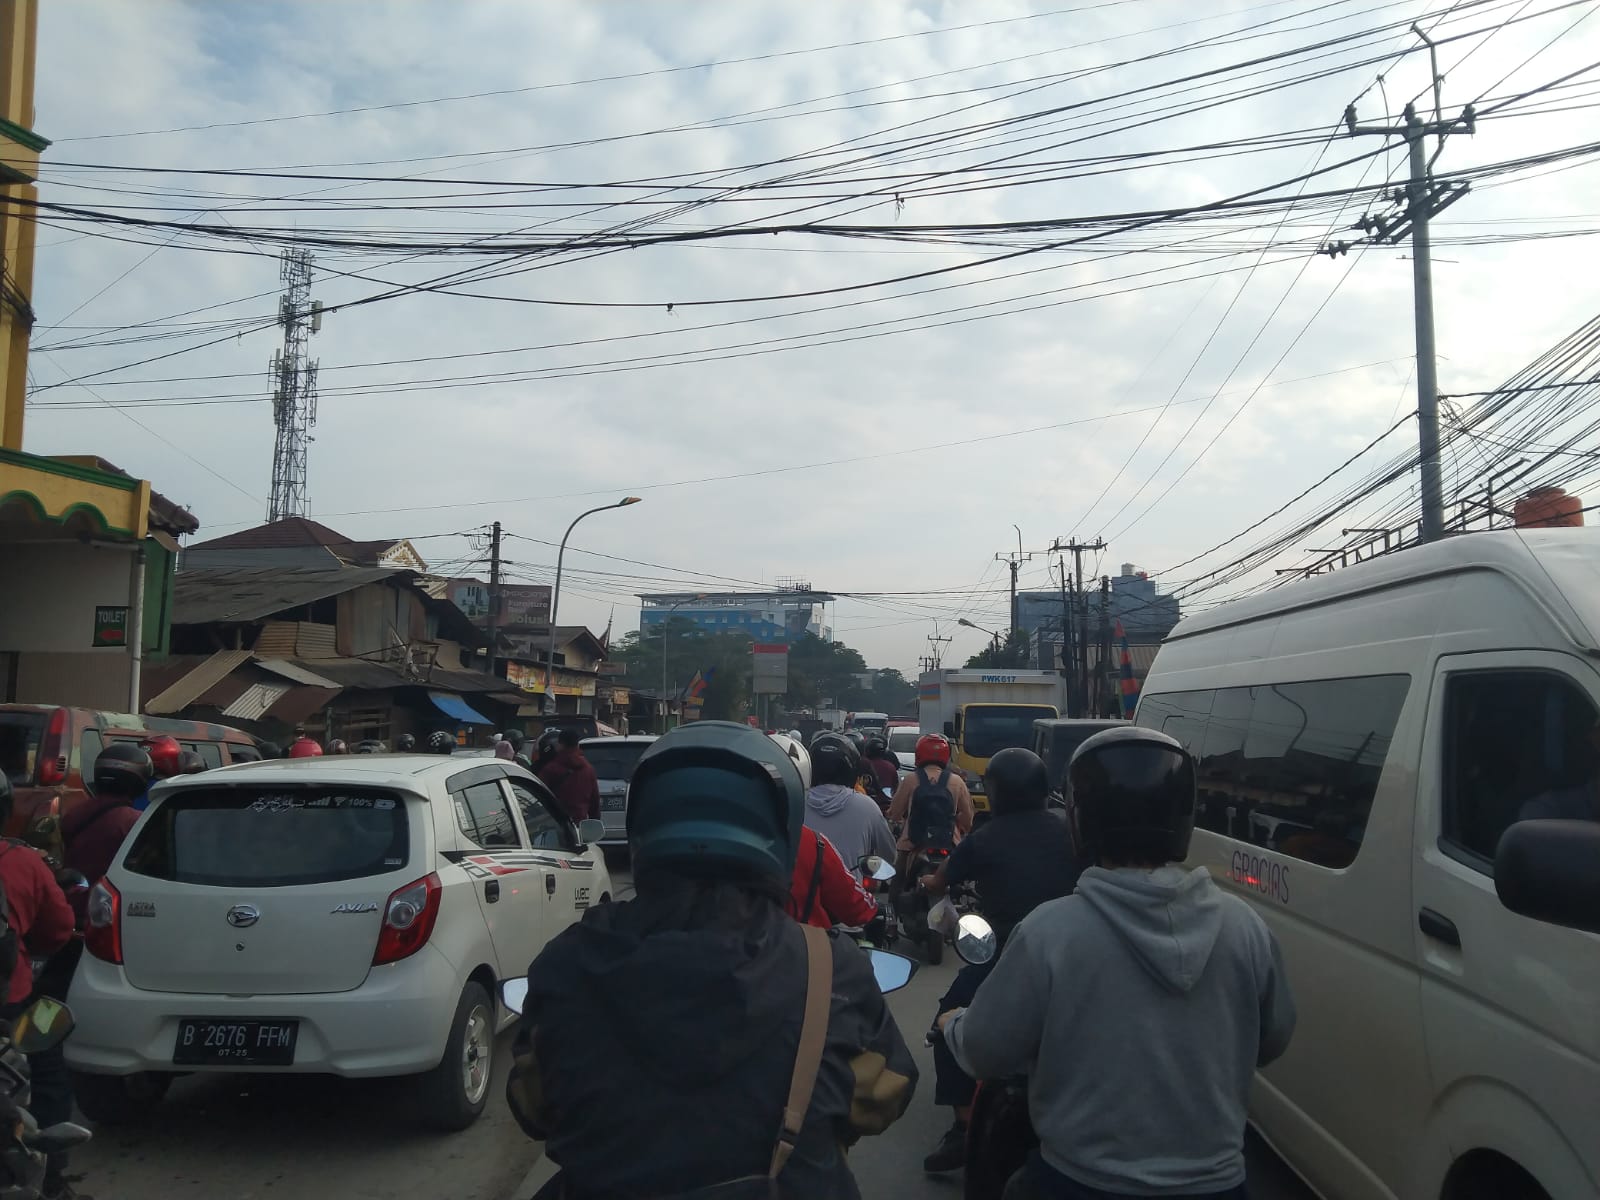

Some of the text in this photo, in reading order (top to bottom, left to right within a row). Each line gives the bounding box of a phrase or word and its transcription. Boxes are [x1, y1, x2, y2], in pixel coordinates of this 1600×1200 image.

[98, 611, 126, 623] TOILET
[347, 798, 373, 807] 100%
[1231, 850, 1290, 904] GRACIAS
[183, 1024, 291, 1047] B 2676 FFM
[218, 1049, 248, 1057] 07-25
